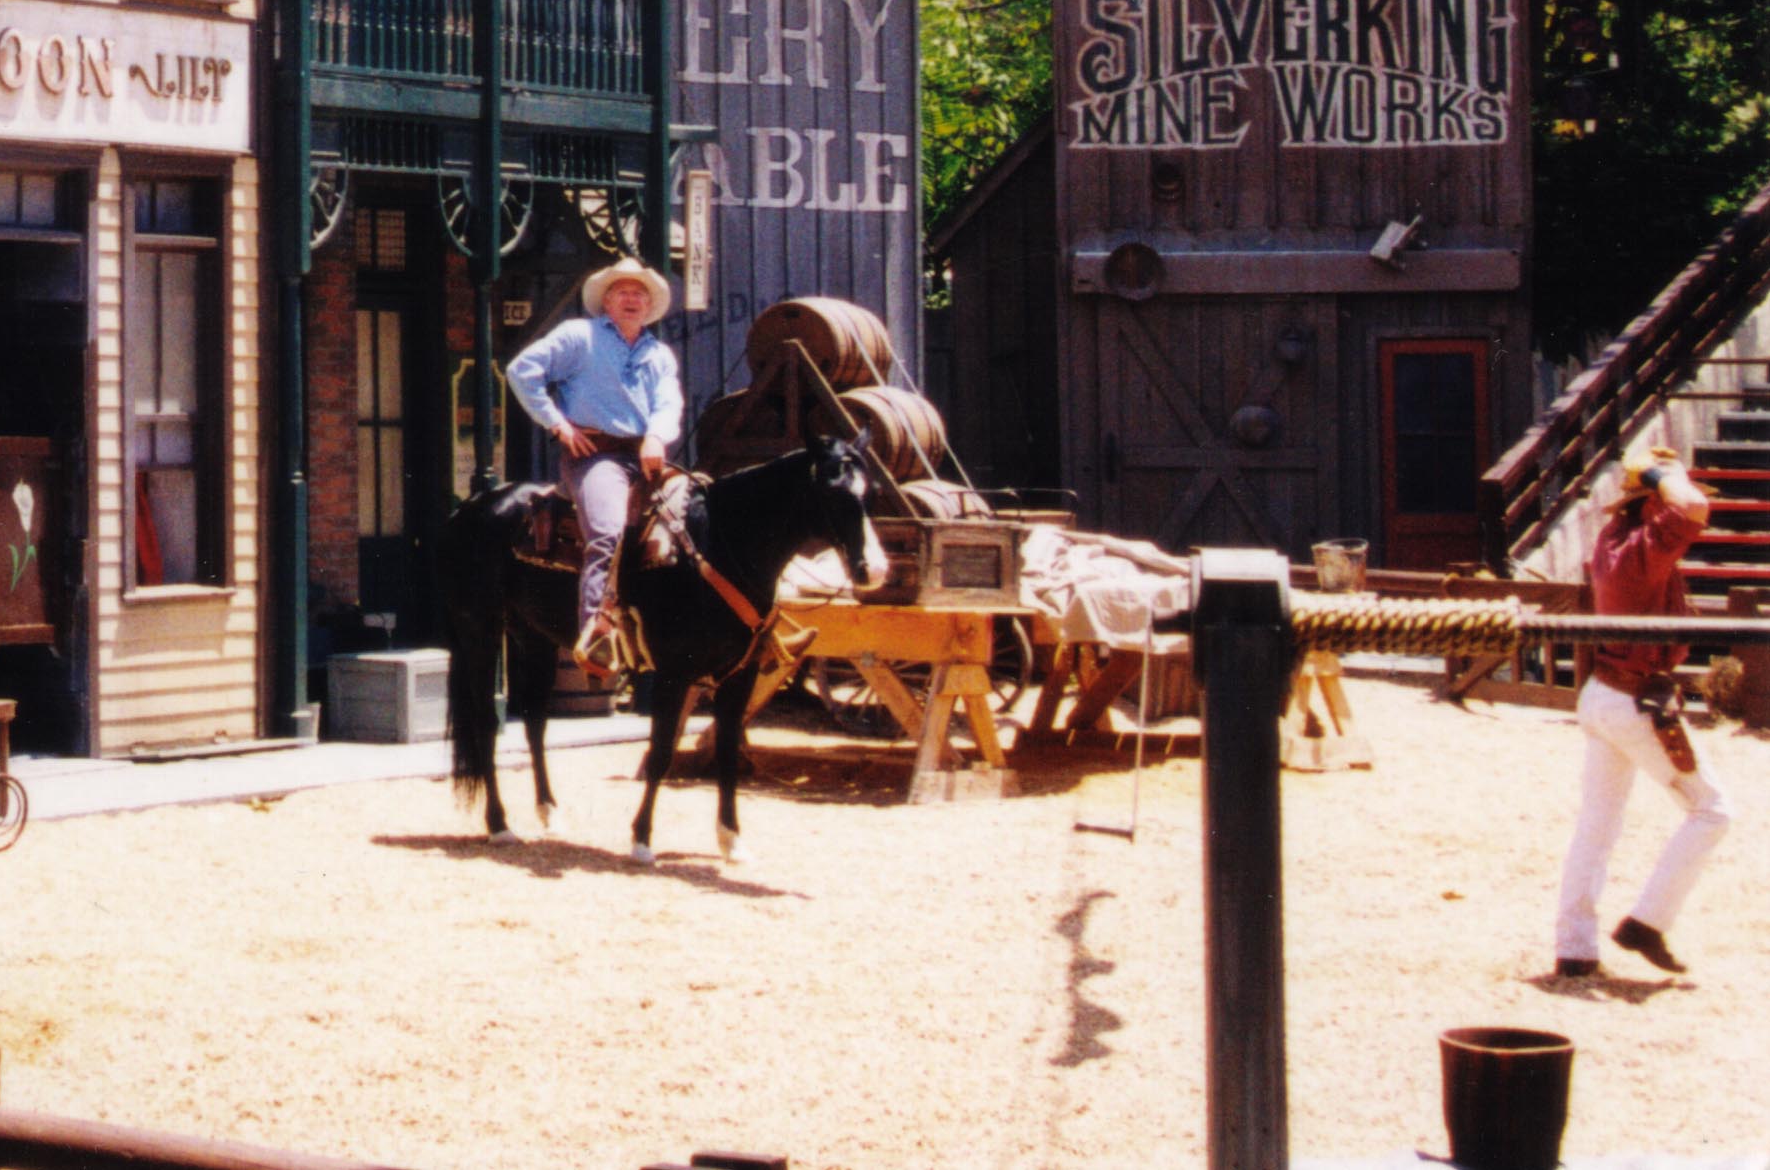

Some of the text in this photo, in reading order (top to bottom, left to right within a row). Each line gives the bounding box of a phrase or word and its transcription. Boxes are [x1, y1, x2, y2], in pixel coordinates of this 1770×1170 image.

[1069, 63, 1508, 149] MINE WORKS
[669, 126, 908, 212] ABLE
